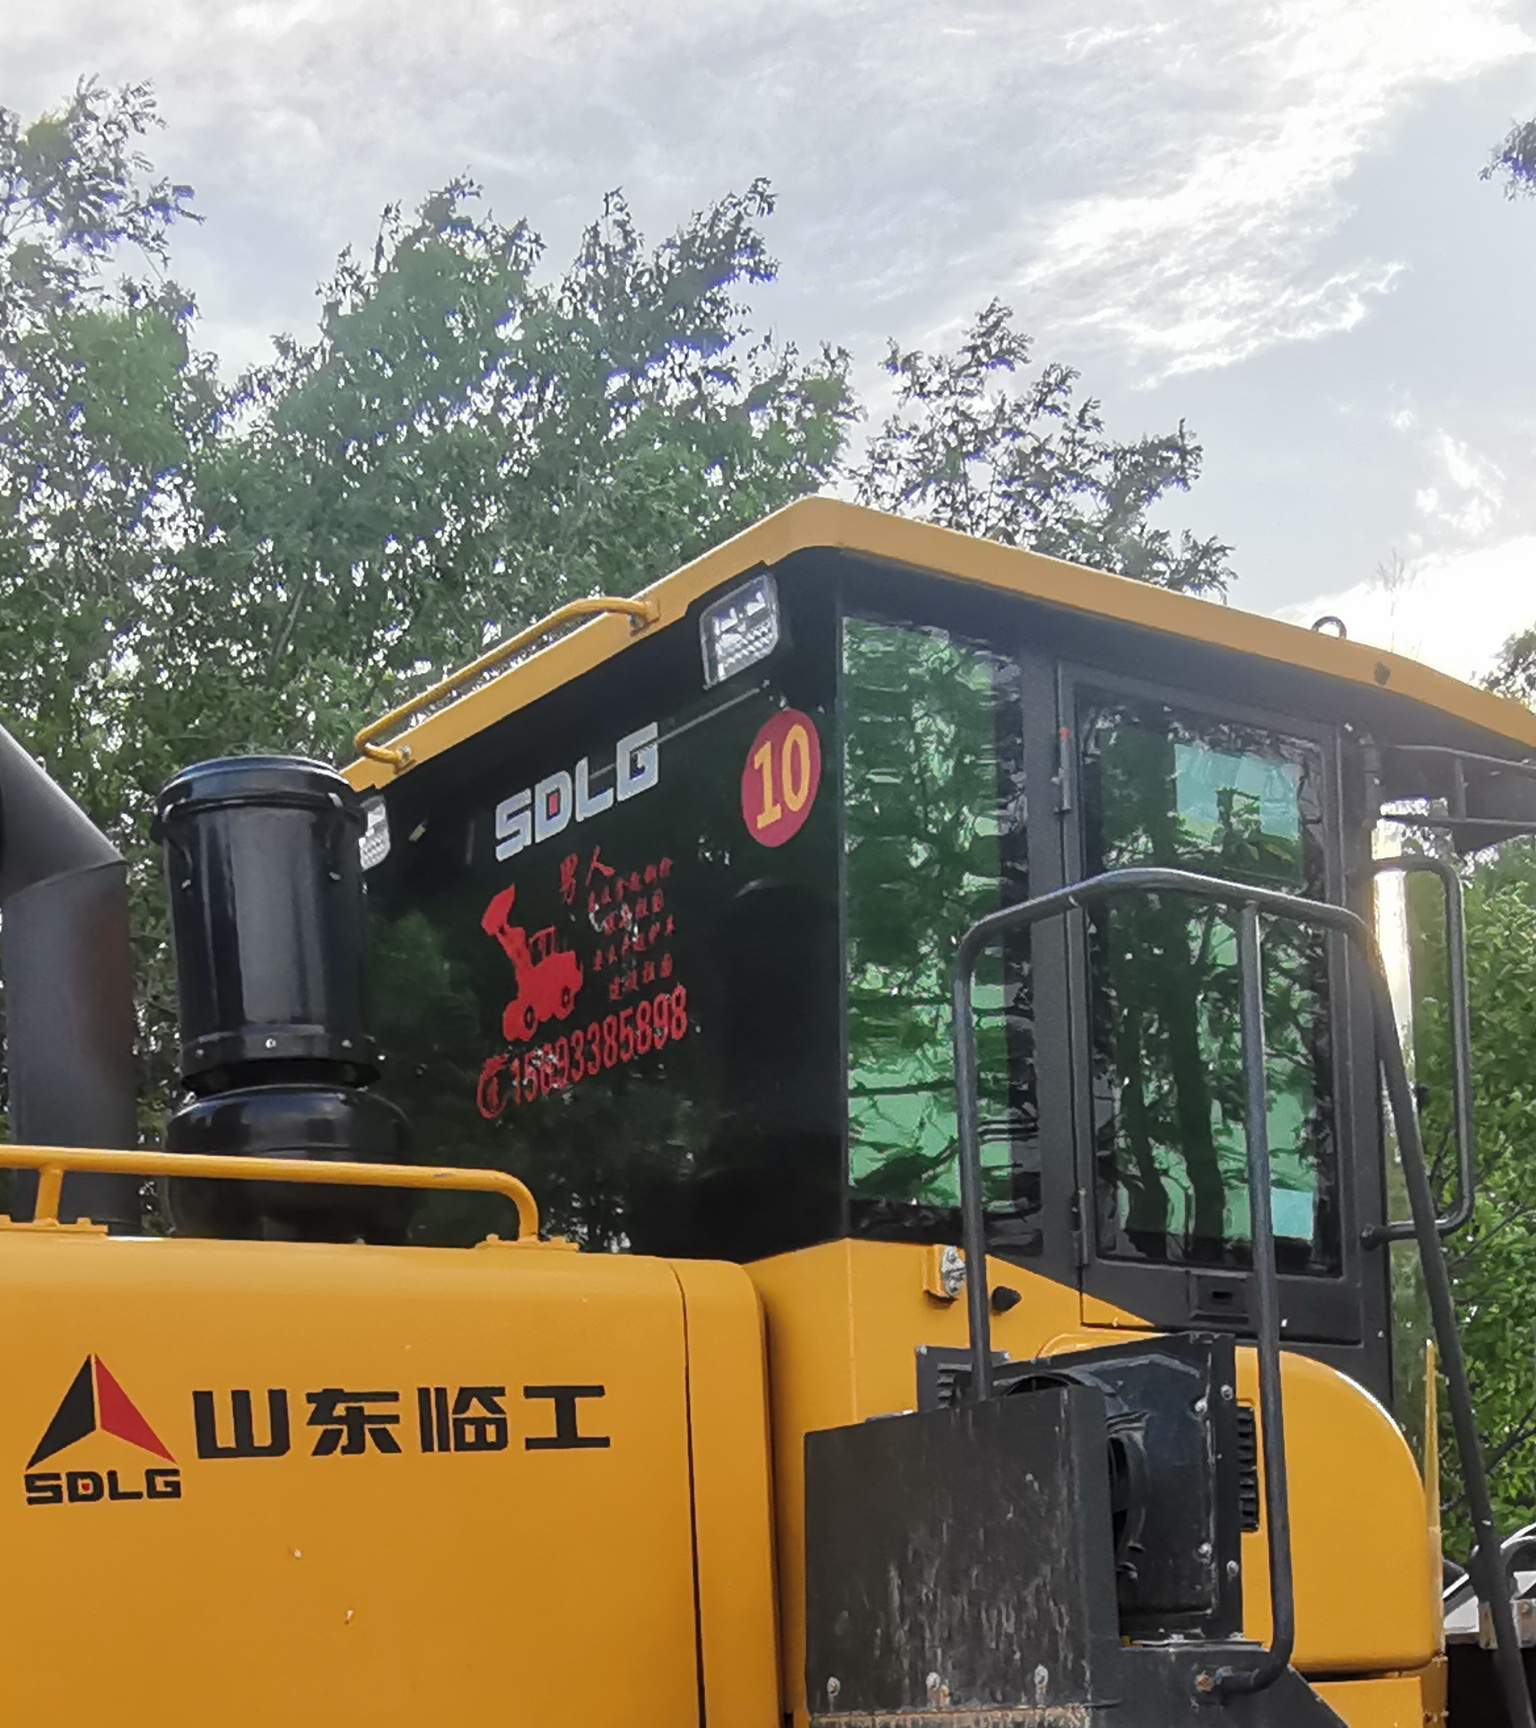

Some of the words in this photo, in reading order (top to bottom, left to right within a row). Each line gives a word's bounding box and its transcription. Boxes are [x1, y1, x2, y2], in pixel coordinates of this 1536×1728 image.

[495, 721, 659, 862] SDLG
[753, 724, 810, 830] 10
[192, 1384, 612, 1460] 山东临工
[24, 1467, 182, 1506] SDLG
